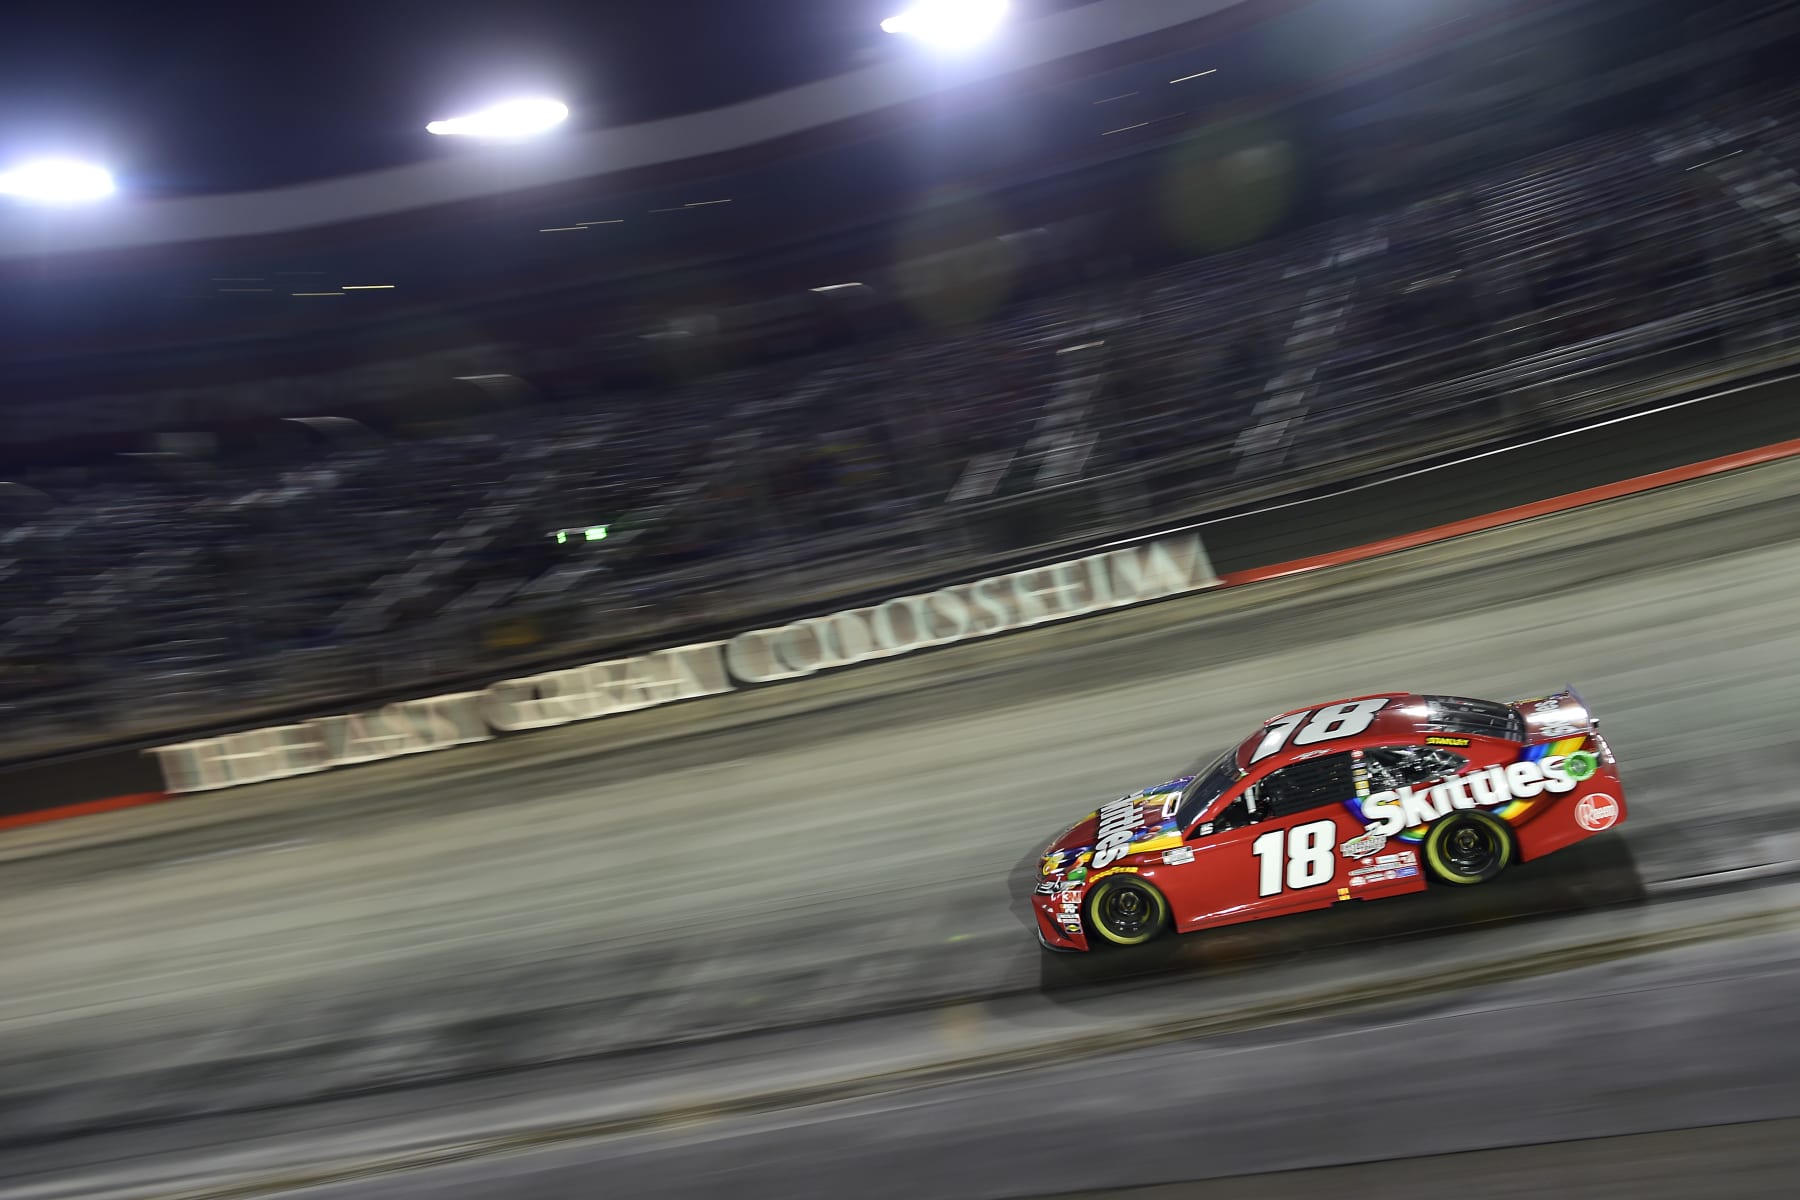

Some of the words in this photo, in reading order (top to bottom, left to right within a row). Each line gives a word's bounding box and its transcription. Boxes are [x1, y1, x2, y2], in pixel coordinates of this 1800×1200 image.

[1250, 699, 1390, 765] 18
[1361, 755, 1578, 837] Skittles
[1253, 820, 1336, 897] 18
